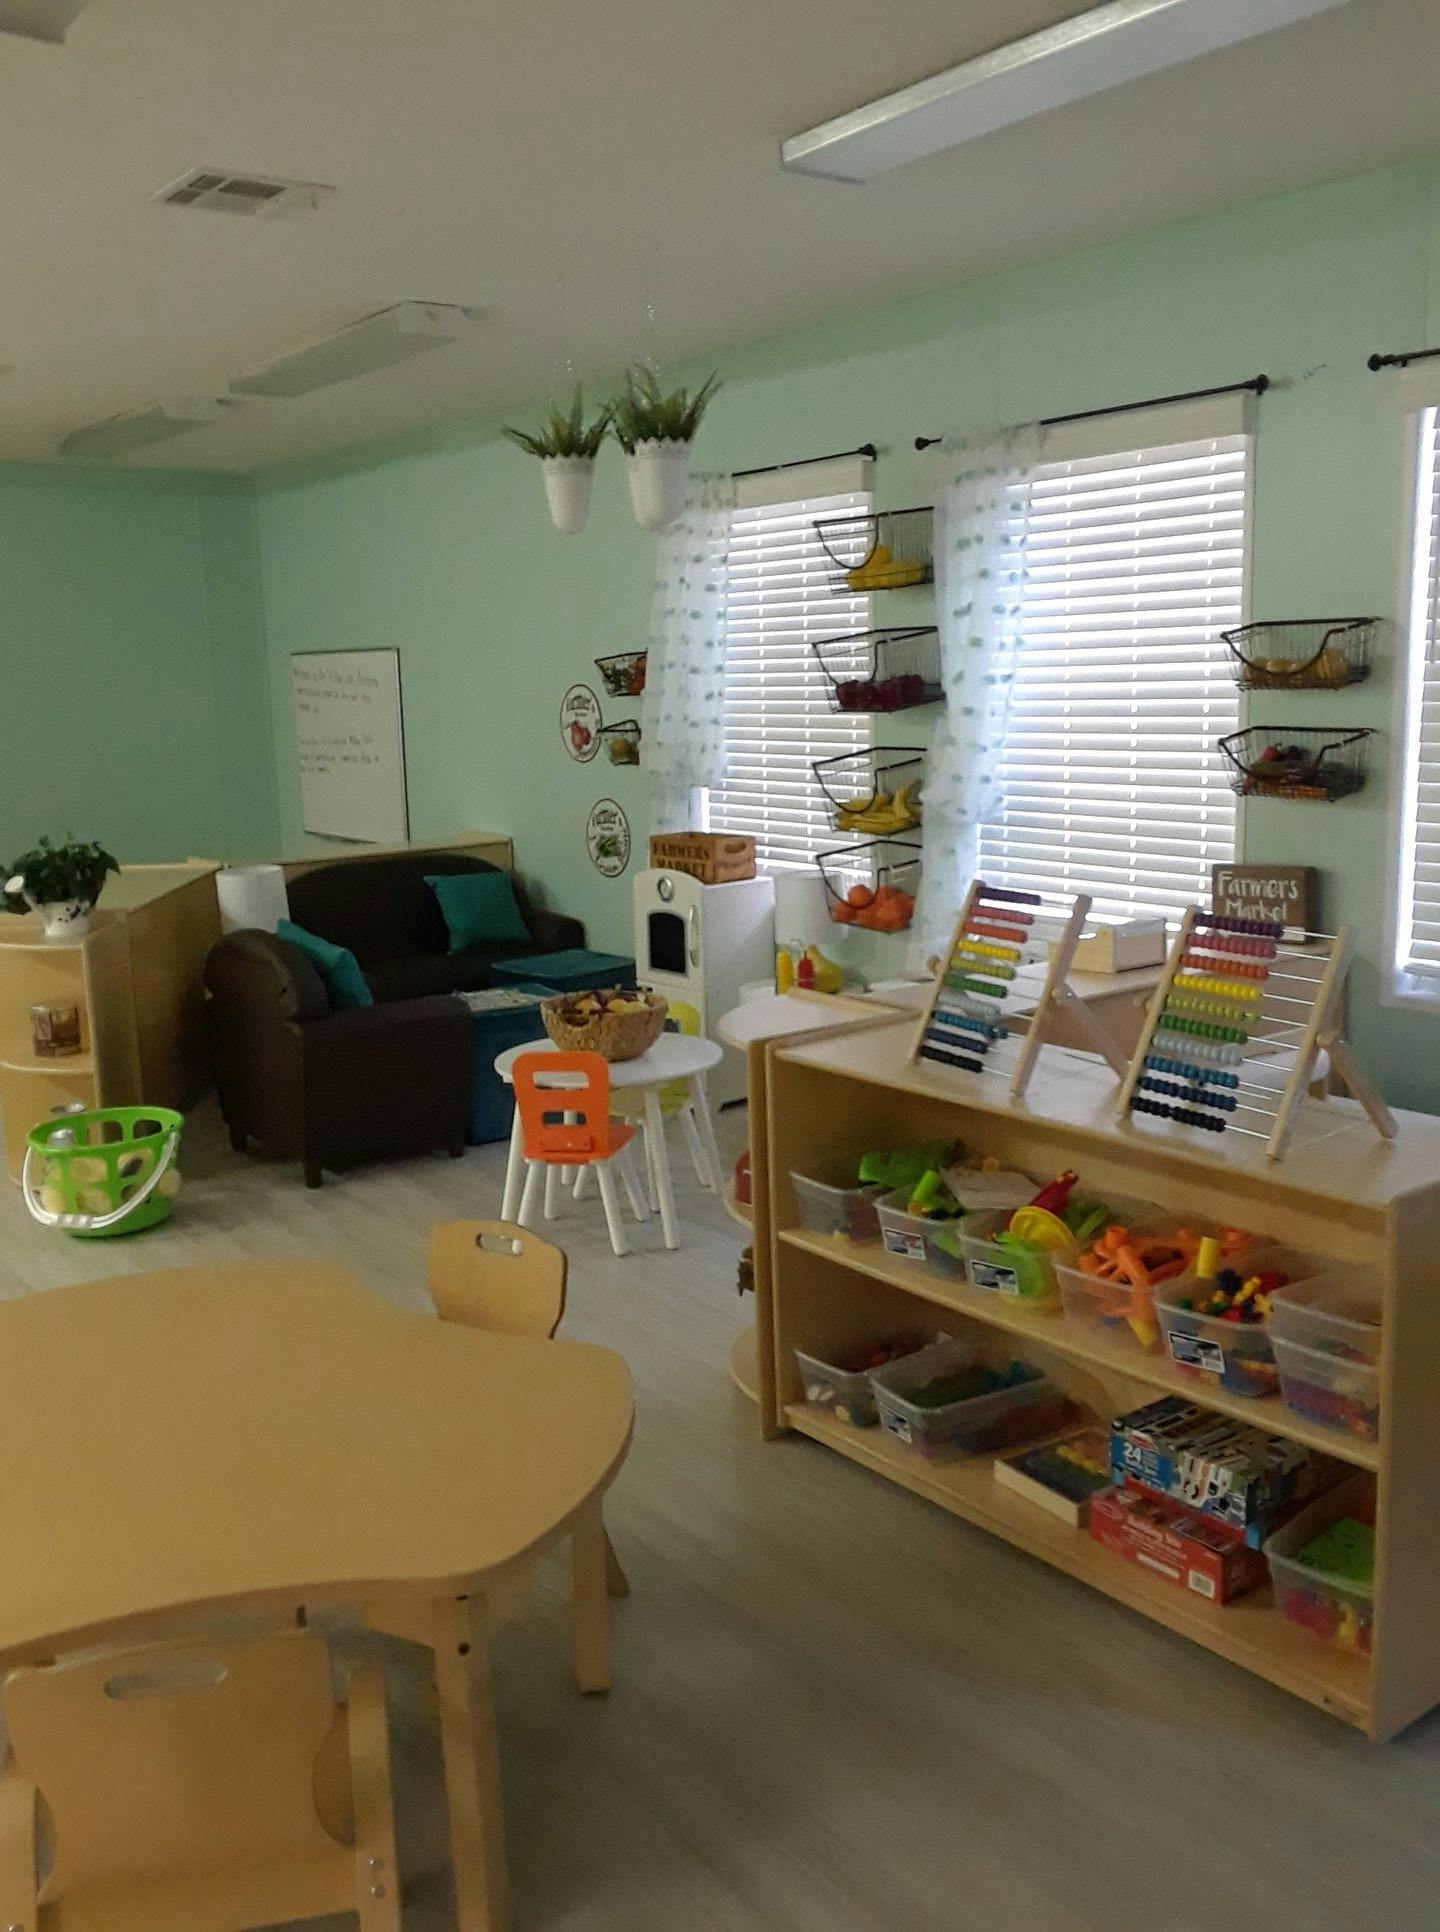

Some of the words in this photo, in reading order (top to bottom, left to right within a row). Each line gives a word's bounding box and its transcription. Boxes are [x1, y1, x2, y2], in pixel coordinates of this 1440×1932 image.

[653, 842, 710, 860] FARMERS
[1218, 870, 1298, 899] Farmers
[1225, 898, 1288, 921] Market
[1123, 1442, 1143, 1464] 24
